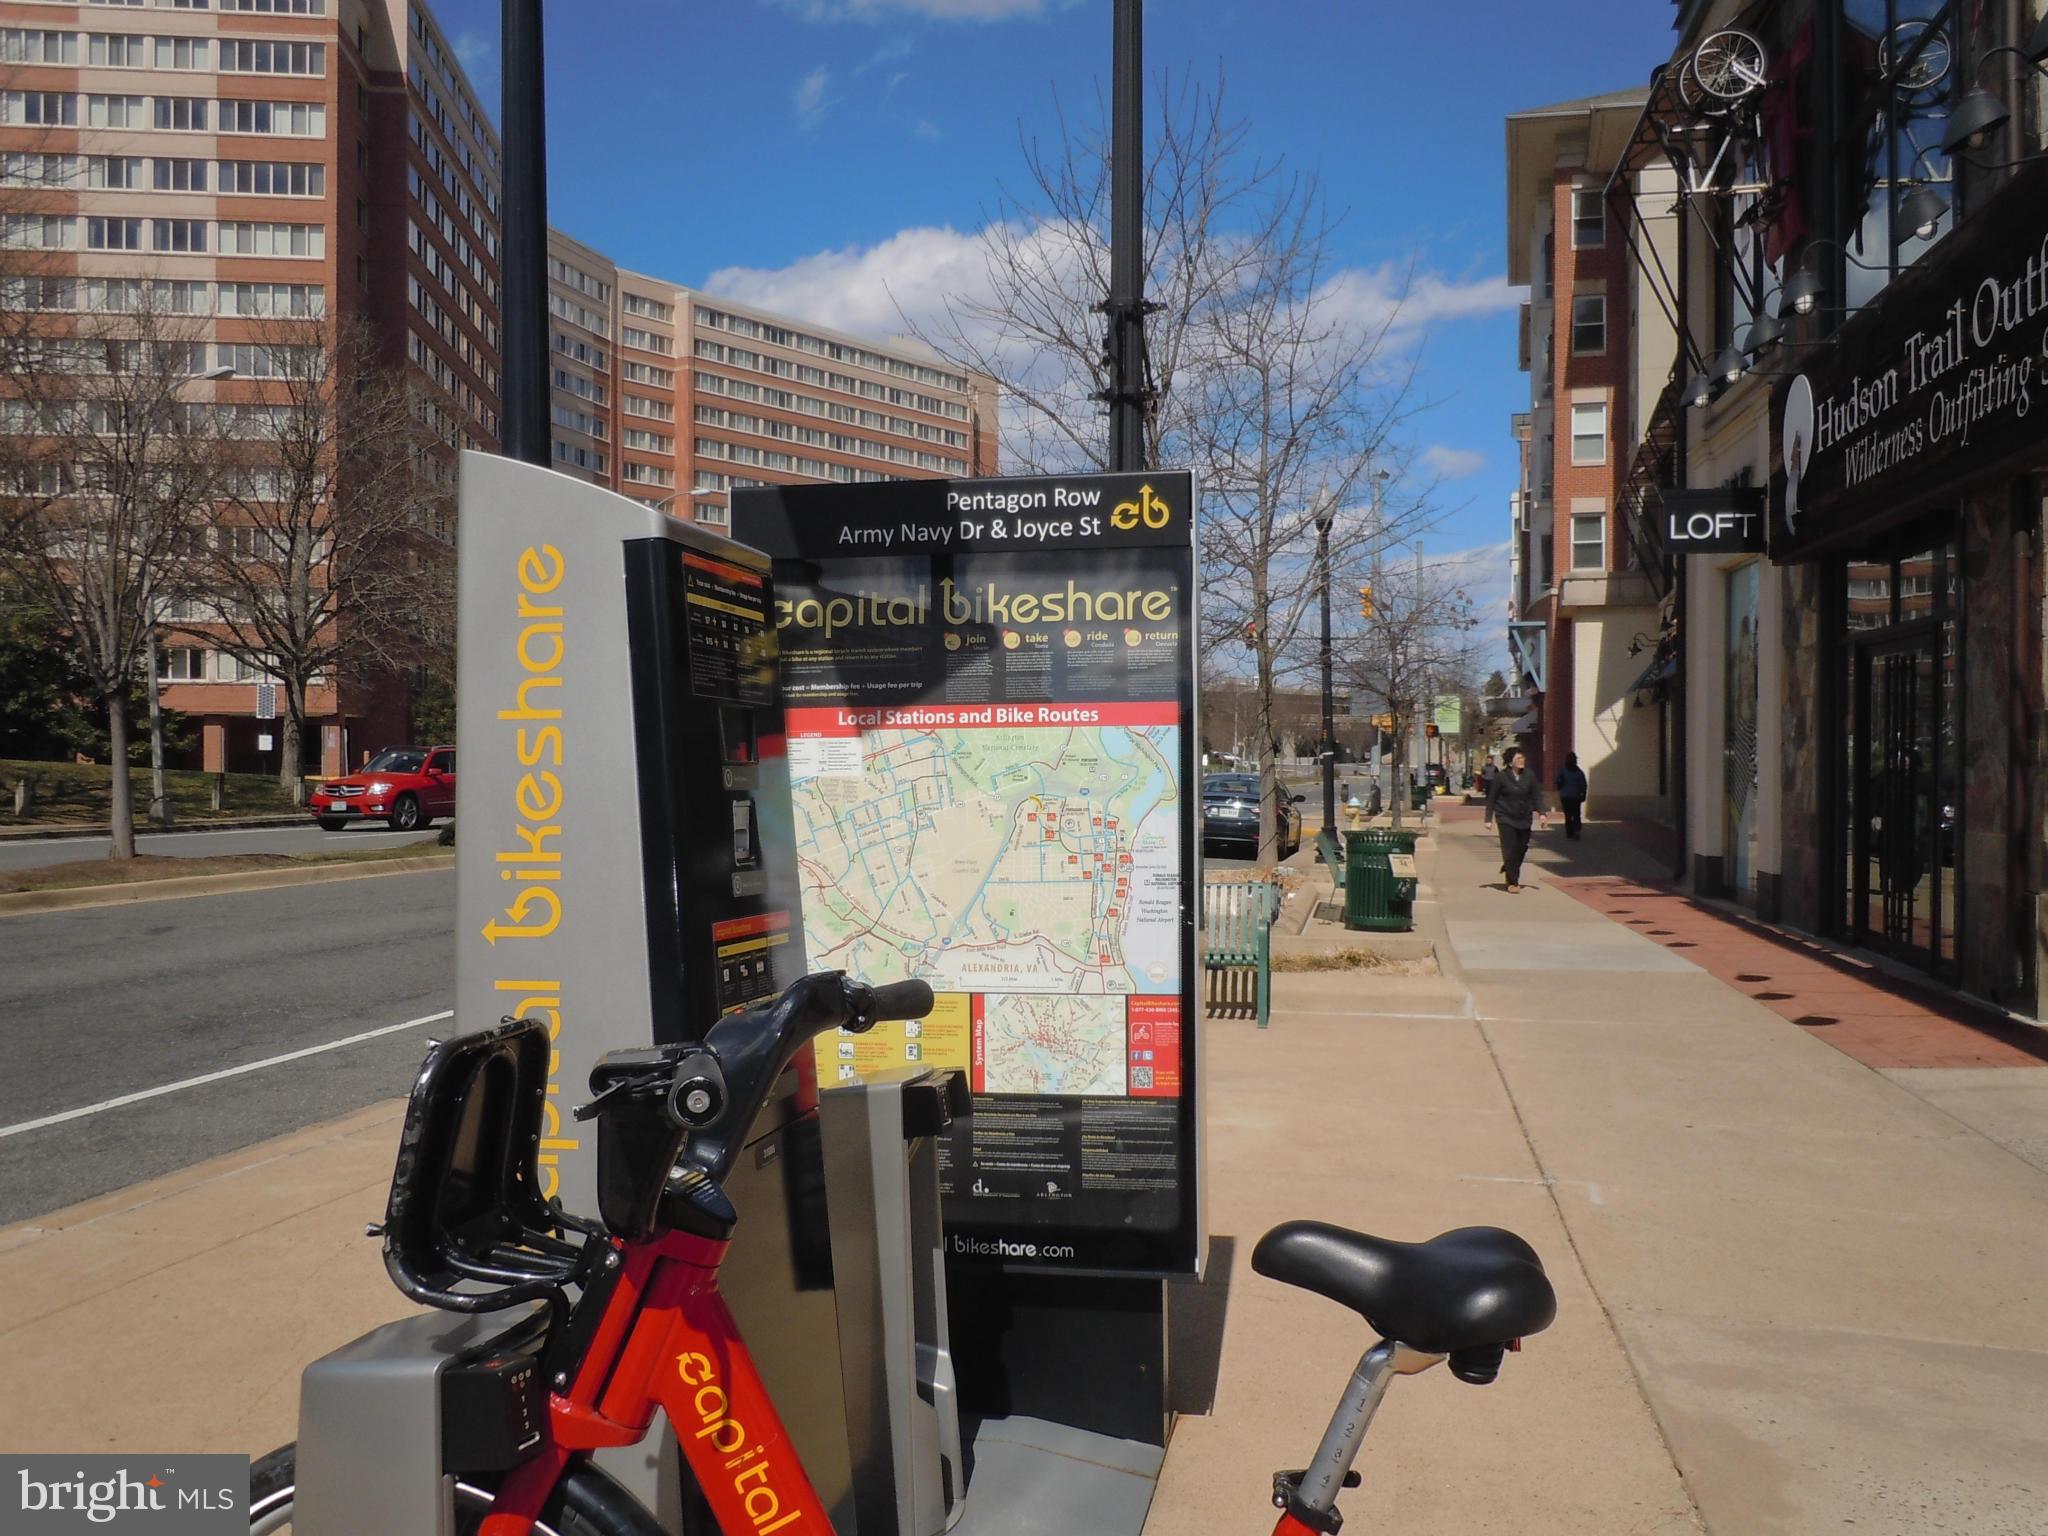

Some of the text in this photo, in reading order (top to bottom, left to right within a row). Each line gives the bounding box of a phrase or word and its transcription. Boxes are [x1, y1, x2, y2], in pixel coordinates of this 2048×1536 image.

[1817, 367, 1898, 453] Hudson
[1905, 298, 1966, 394] Trail
[1845, 418, 1923, 489] Wilderness
[1929, 354, 2032, 447] Outfitting
[946, 488, 1101, 513] Pentagon Row
[838, 516, 1101, 547] Army Navy Dr & Joyce St
[1670, 513, 1756, 540] LOFT
[939, 577, 1172, 626] bikeshare
[965, 632, 1179, 646] join take ride return
[838, 706, 1099, 726] Local Stations and Bike Routes
[481, 543, 566, 946] bikeshare
[961, 963, 1038, 974] ALEXANDRIA, VA
[975, 1019, 984, 1066] System Map
[676, 1352, 801, 1536] capital
